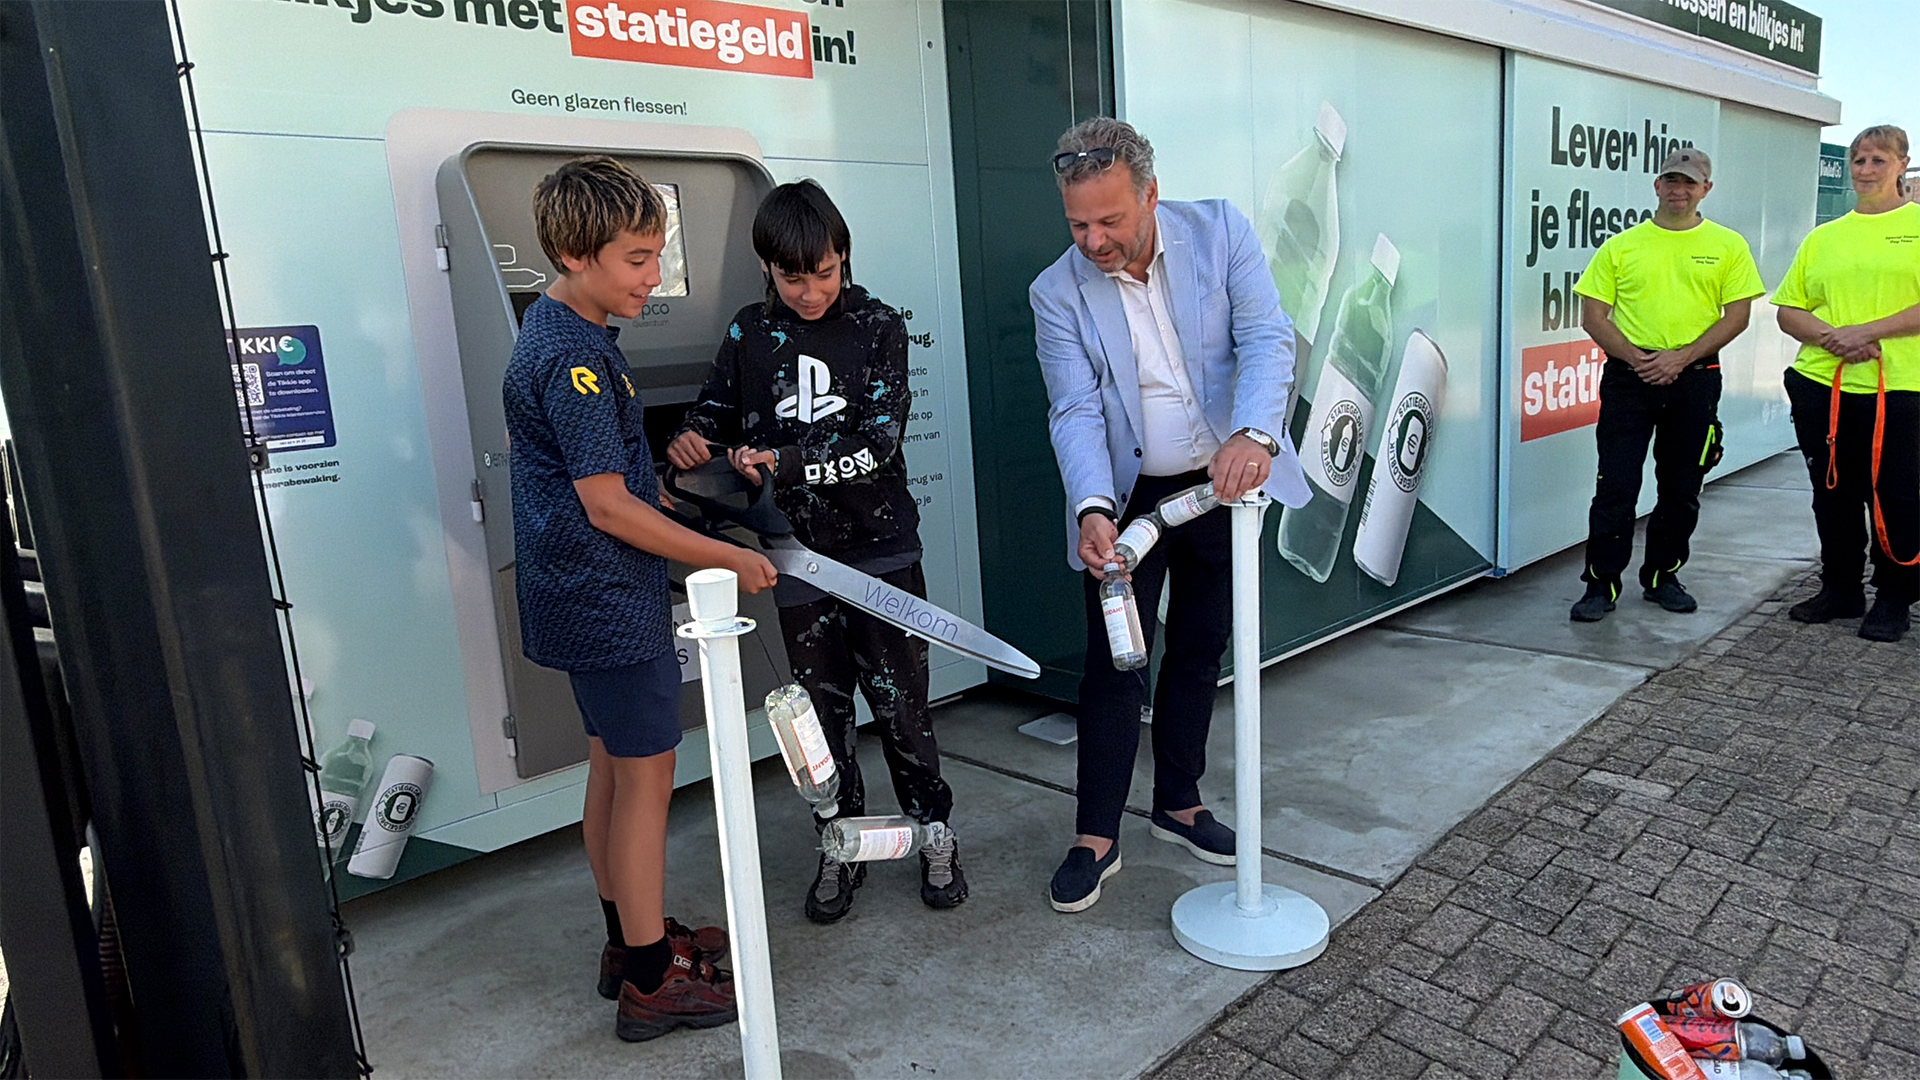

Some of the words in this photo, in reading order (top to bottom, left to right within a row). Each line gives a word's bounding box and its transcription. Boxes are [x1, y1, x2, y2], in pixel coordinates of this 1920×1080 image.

[453, 0, 564, 33] met
[575, 3, 804, 64] statiegeld
[812, 25, 857, 65] in!
[1668, 0, 1726, 24] essen
[1728, 7, 1747, 31] en
[1748, 4, 1789, 50] blikjes
[1790, 19, 1805, 52] in!
[511, 88, 560, 107] Geen
[564, 93, 620, 112] glazen
[623, 97, 688, 115] flessen!
[1551, 106, 1637, 172] Lever
[1643, 119, 1694, 175] hi
[1526, 189, 1559, 268] je
[908, 331, 935, 348] rug.
[1524, 347, 1607, 416] stati
[920, 387, 929, 397] in
[921, 411, 933, 420] op
[902, 432, 922, 444] erm
[924, 430, 941, 440] van
[295, 460, 340, 471] voorzien
[263, 474, 341, 490] merabewaking.
[906, 475, 929, 486] erug
[930, 472, 943, 482] via
[922, 494, 932, 506] je
[864, 581, 959, 641] Welkom
